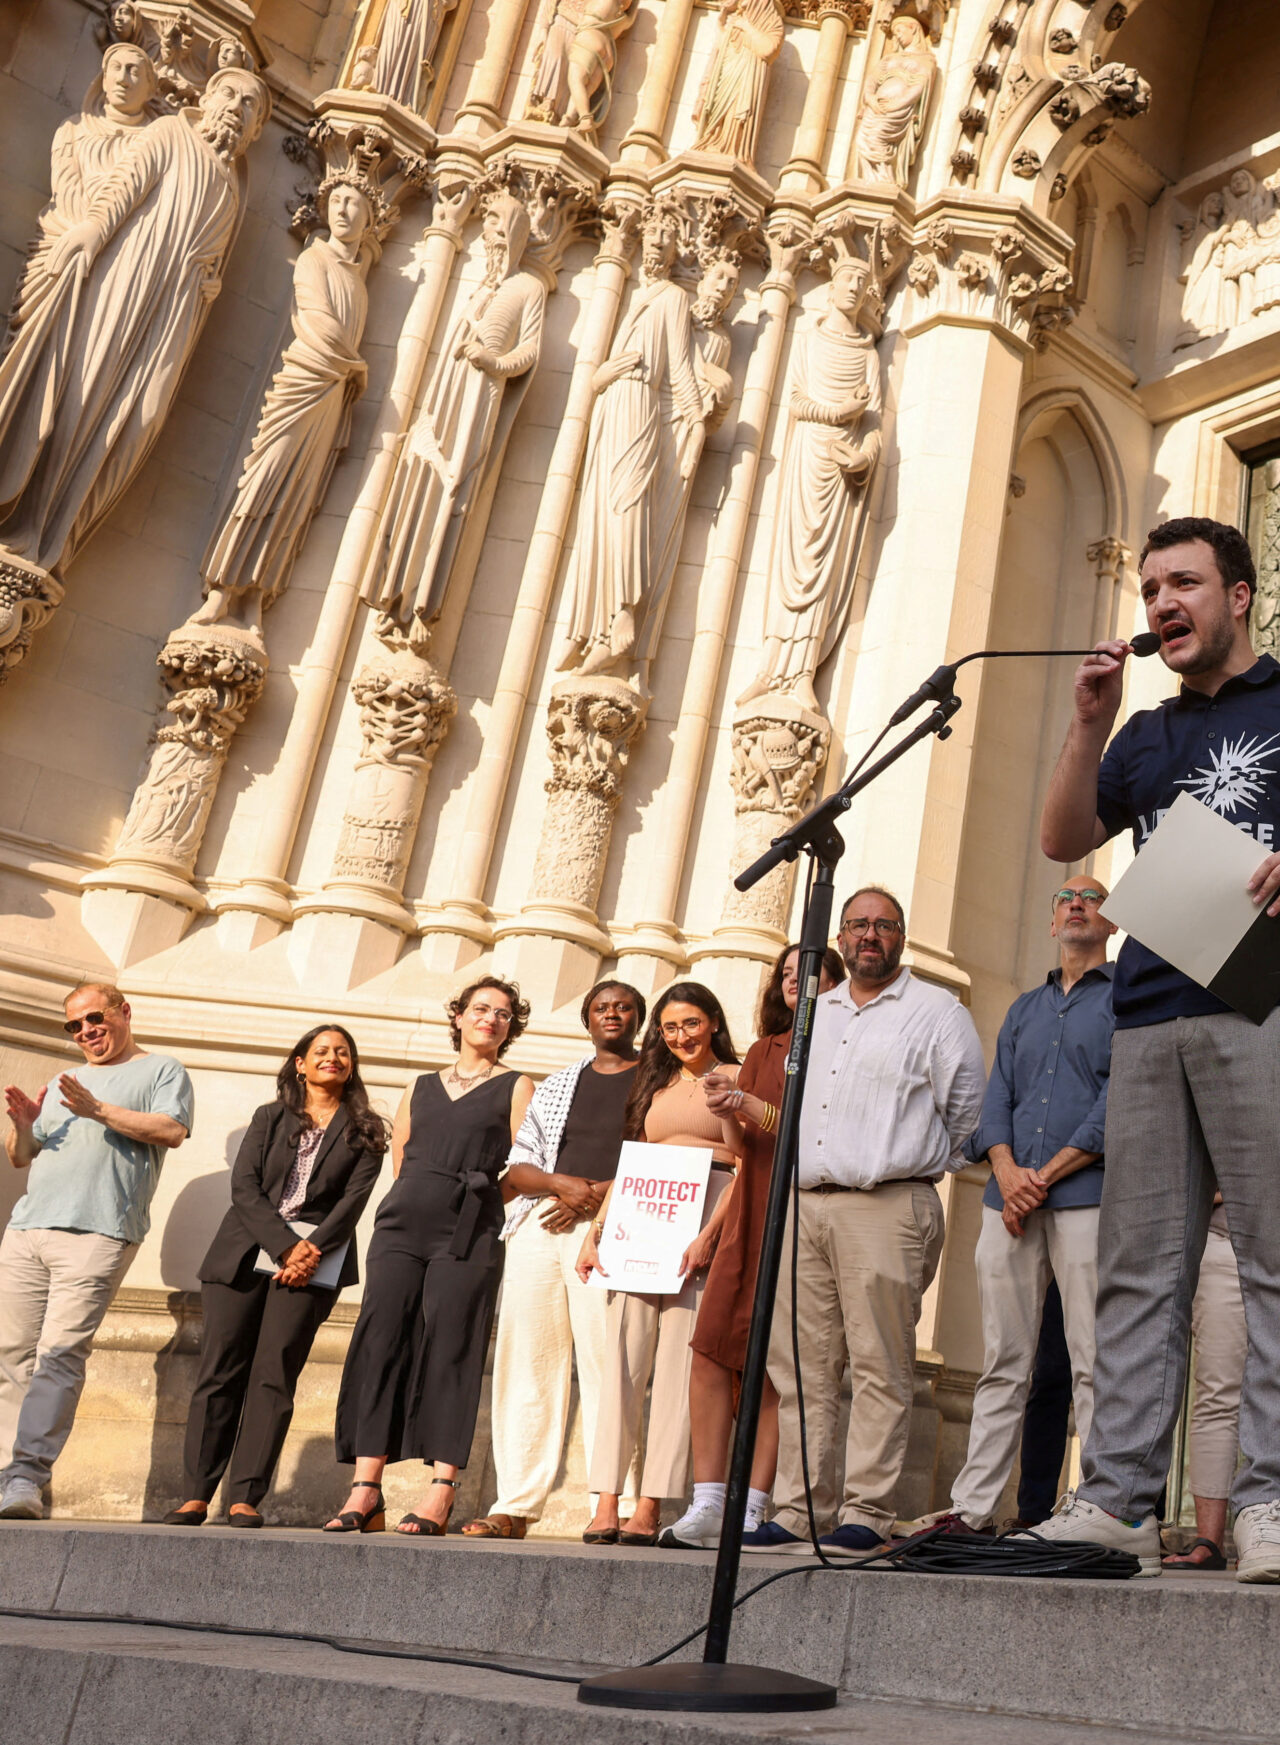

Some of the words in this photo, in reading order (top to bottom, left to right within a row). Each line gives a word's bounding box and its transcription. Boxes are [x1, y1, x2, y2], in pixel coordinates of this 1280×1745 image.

[791, 997, 808, 1060] OXYGEN
[620, 1176, 701, 1203] PROTECT
[636, 1200, 679, 1224] FREE
